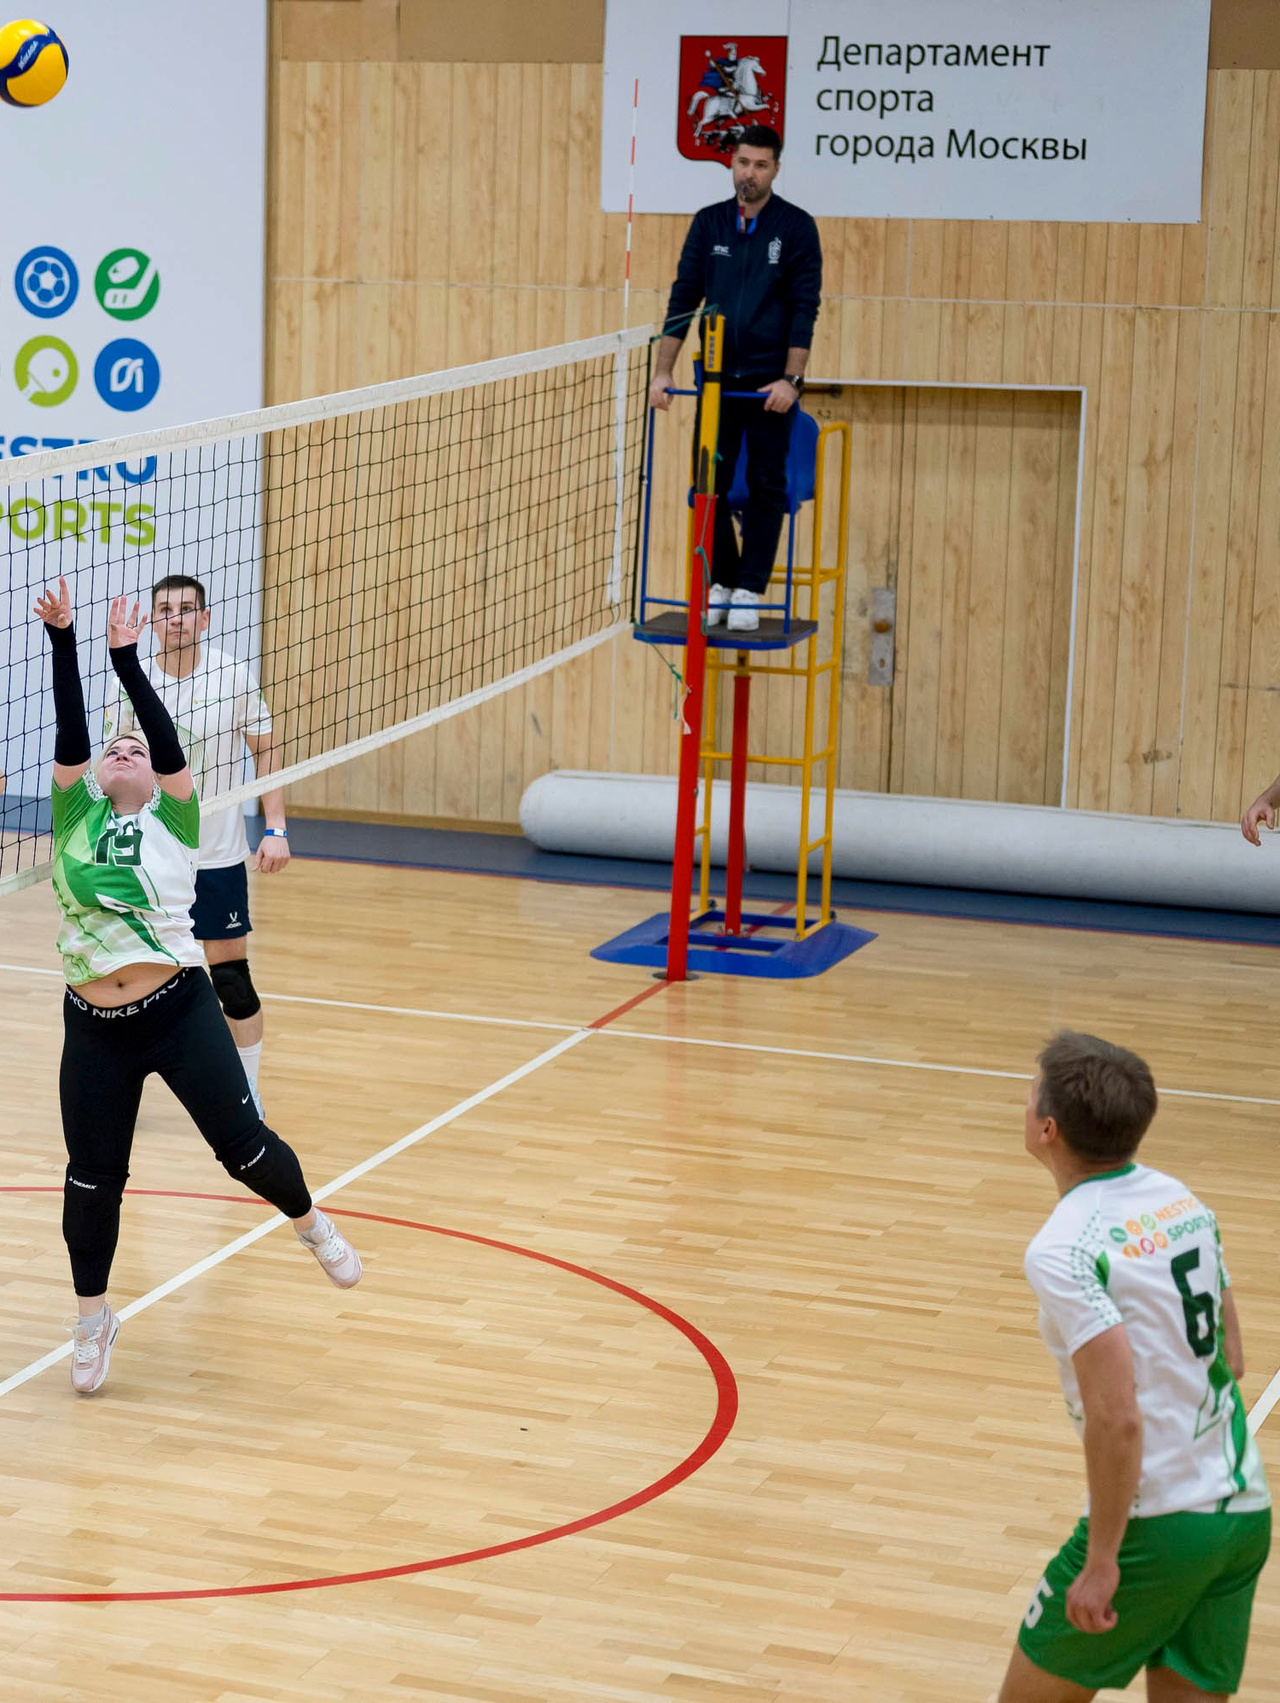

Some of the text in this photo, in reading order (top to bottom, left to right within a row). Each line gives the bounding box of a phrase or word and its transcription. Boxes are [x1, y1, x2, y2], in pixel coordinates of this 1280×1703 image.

[817, 36, 1051, 74] Департамент
[816, 89, 934, 119] спорта
[815, 128, 1087, 164] города Москвы
[95, 820, 144, 867] 19
[92, 1003, 140, 1019] NIKE
[1170, 1247, 1216, 1358] 6
[1023, 1576, 1055, 1630] 6
